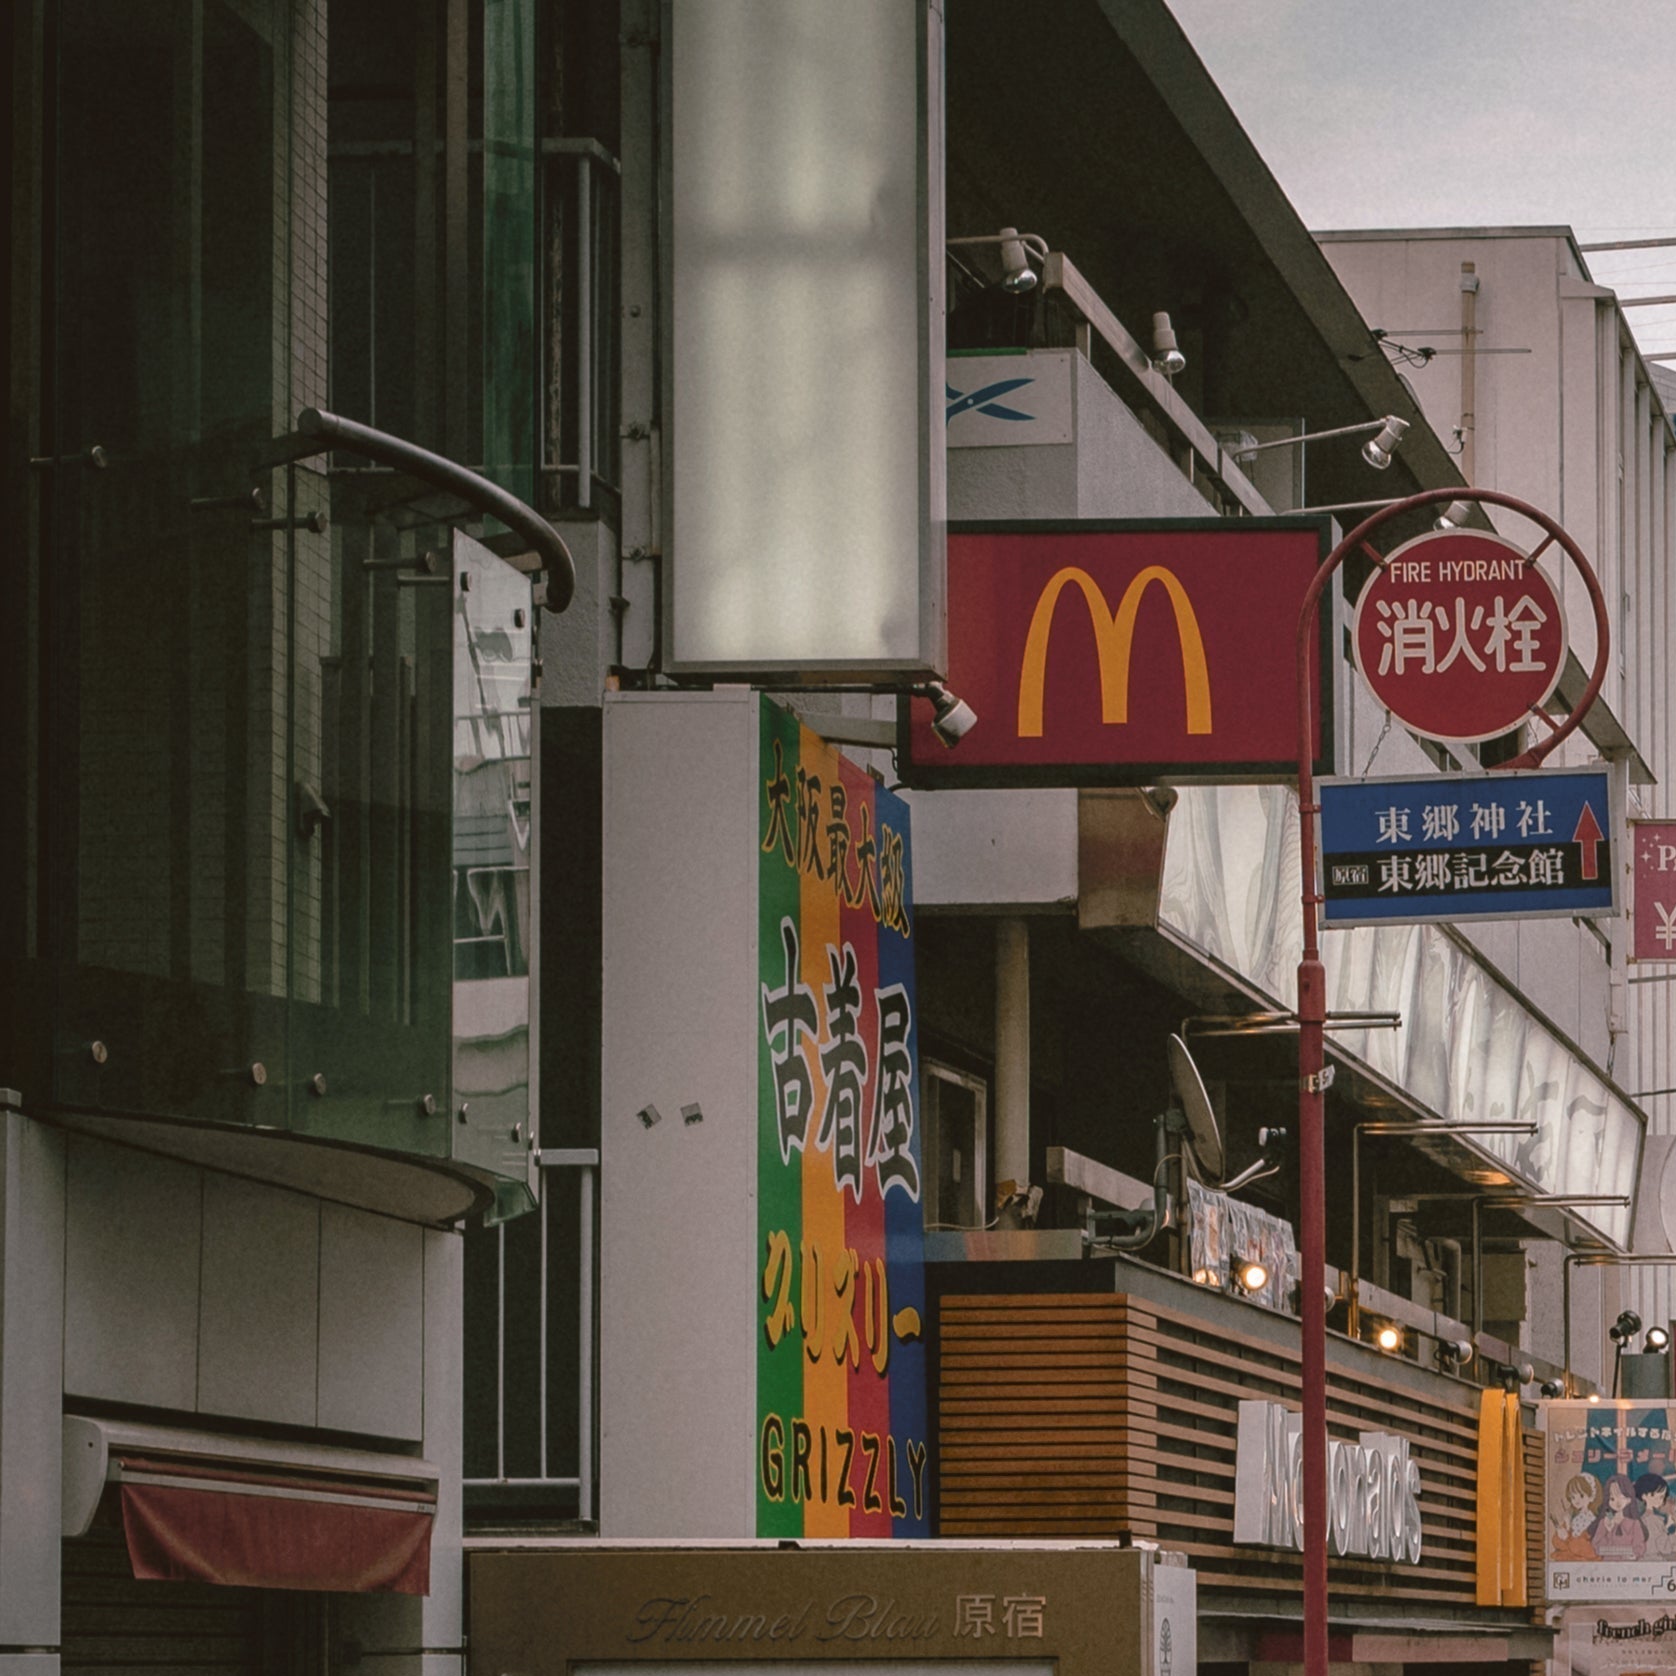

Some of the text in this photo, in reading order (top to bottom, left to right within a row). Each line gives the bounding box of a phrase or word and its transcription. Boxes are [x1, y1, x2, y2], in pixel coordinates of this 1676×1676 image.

[1391, 559, 1527, 584] FIRE HYDRANT
[1376, 595, 1548, 676] 消火栓
[759, 739, 912, 940] 大阪最大級
[1375, 799, 1554, 844] 東郷神社
[1332, 848, 1565, 893] 原宿 東郷記念館
[761, 917, 921, 1205] 古着屋
[763, 1229, 923, 1376] グリズリー
[761, 1417, 927, 1520] GRIZZLY
[815, 1594, 942, 1642] Blau
[953, 1593, 1046, 1639] 原宿
